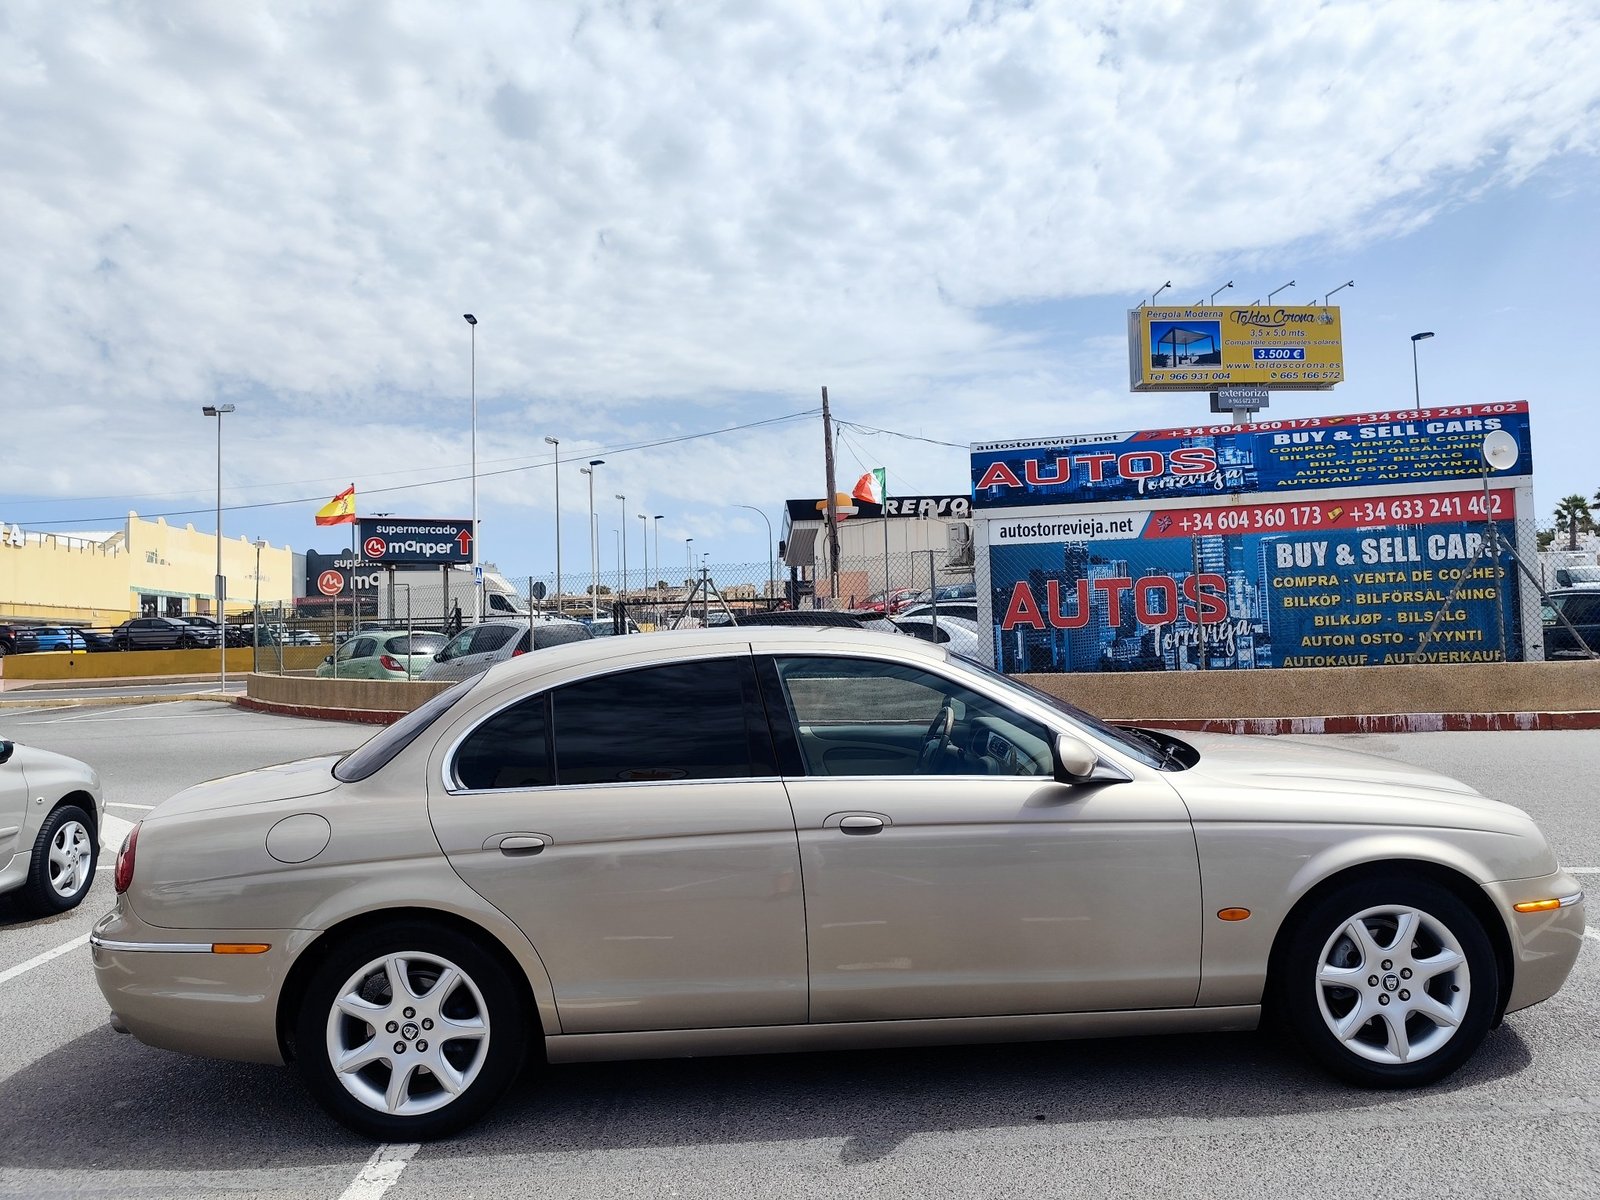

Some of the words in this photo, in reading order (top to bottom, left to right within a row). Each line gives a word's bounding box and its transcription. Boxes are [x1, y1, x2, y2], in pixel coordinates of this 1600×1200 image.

[1185, 310, 1223, 318] Moderna
[1230, 310, 1270, 326] Toldos
[1274, 309, 1315, 323] Corona
[1250, 329, 1263, 337] 3,5
[1258, 349, 1290, 358] 3.500
[1293, 349, 1301, 358] €
[1219, 389, 1268, 397] exterioriza
[1168, 426, 1204, 438] +34
[1209, 425, 1242, 434] 604
[1249, 422, 1282, 430] 360
[1288, 419, 1321, 428] 173
[1351, 413, 1391, 423] +34
[1396, 410, 1432, 420] 633
[1438, 407, 1473, 417] 241
[1481, 403, 1517, 413] 402
[1274, 431, 1326, 446] BUY
[1333, 430, 1352, 441] &
[1360, 424, 1419, 439] SELL
[1426, 418, 1502, 434] CARS
[976, 434, 1120, 451] autostorrevieja.net
[1269, 444, 1336, 454] COMPRA
[1350, 439, 1403, 448] VENTA
[1279, 452, 1337, 461] BILKÖP
[1352, 442, 1482, 457] BILFÖRSÄLJNIN
[1310, 458, 1378, 467] BILKJØP
[1393, 452, 1463, 462] BILSALG
[976, 447, 1218, 490] AUTOS
[1296, 467, 1350, 476] AUTON
[1355, 464, 1399, 473] OSTO
[1414, 459, 1479, 469] MYYNTI
[1132, 467, 1243, 495] Torrevieja
[1277, 475, 1362, 486] AUTOKAUF
[881, 498, 969, 515] REPSO
[1179, 513, 1213, 532] +34
[1217, 510, 1249, 529] 604
[1254, 508, 1286, 528] 360
[1291, 506, 1321, 525] 173
[1350, 502, 1386, 522] +34
[1390, 499, 1424, 519] 633
[1429, 497, 1461, 517] 241
[376, 525, 457, 536] supermercado
[1000, 518, 1134, 538] autostorrevieja.net
[389, 541, 453, 557] manper
[1276, 540, 1328, 569] BUY
[1336, 543, 1355, 566] &
[1361, 535, 1421, 565] SELL
[1273, 575, 1339, 588] COMPRA
[1353, 571, 1406, 585] VENTA
[1412, 570, 1432, 582] DE
[1002, 573, 1228, 631] AUTOS
[1283, 593, 1341, 608] BILKÖP
[1356, 588, 1496, 605] BILFÖRSÄLNING
[1314, 613, 1382, 626] BILKJØP
[1149, 618, 1252, 657] Torrevieja
[1301, 634, 1355, 647] AUTON
[1360, 632, 1403, 645] OSTO
[1283, 654, 1368, 667] AUTOKAUF
